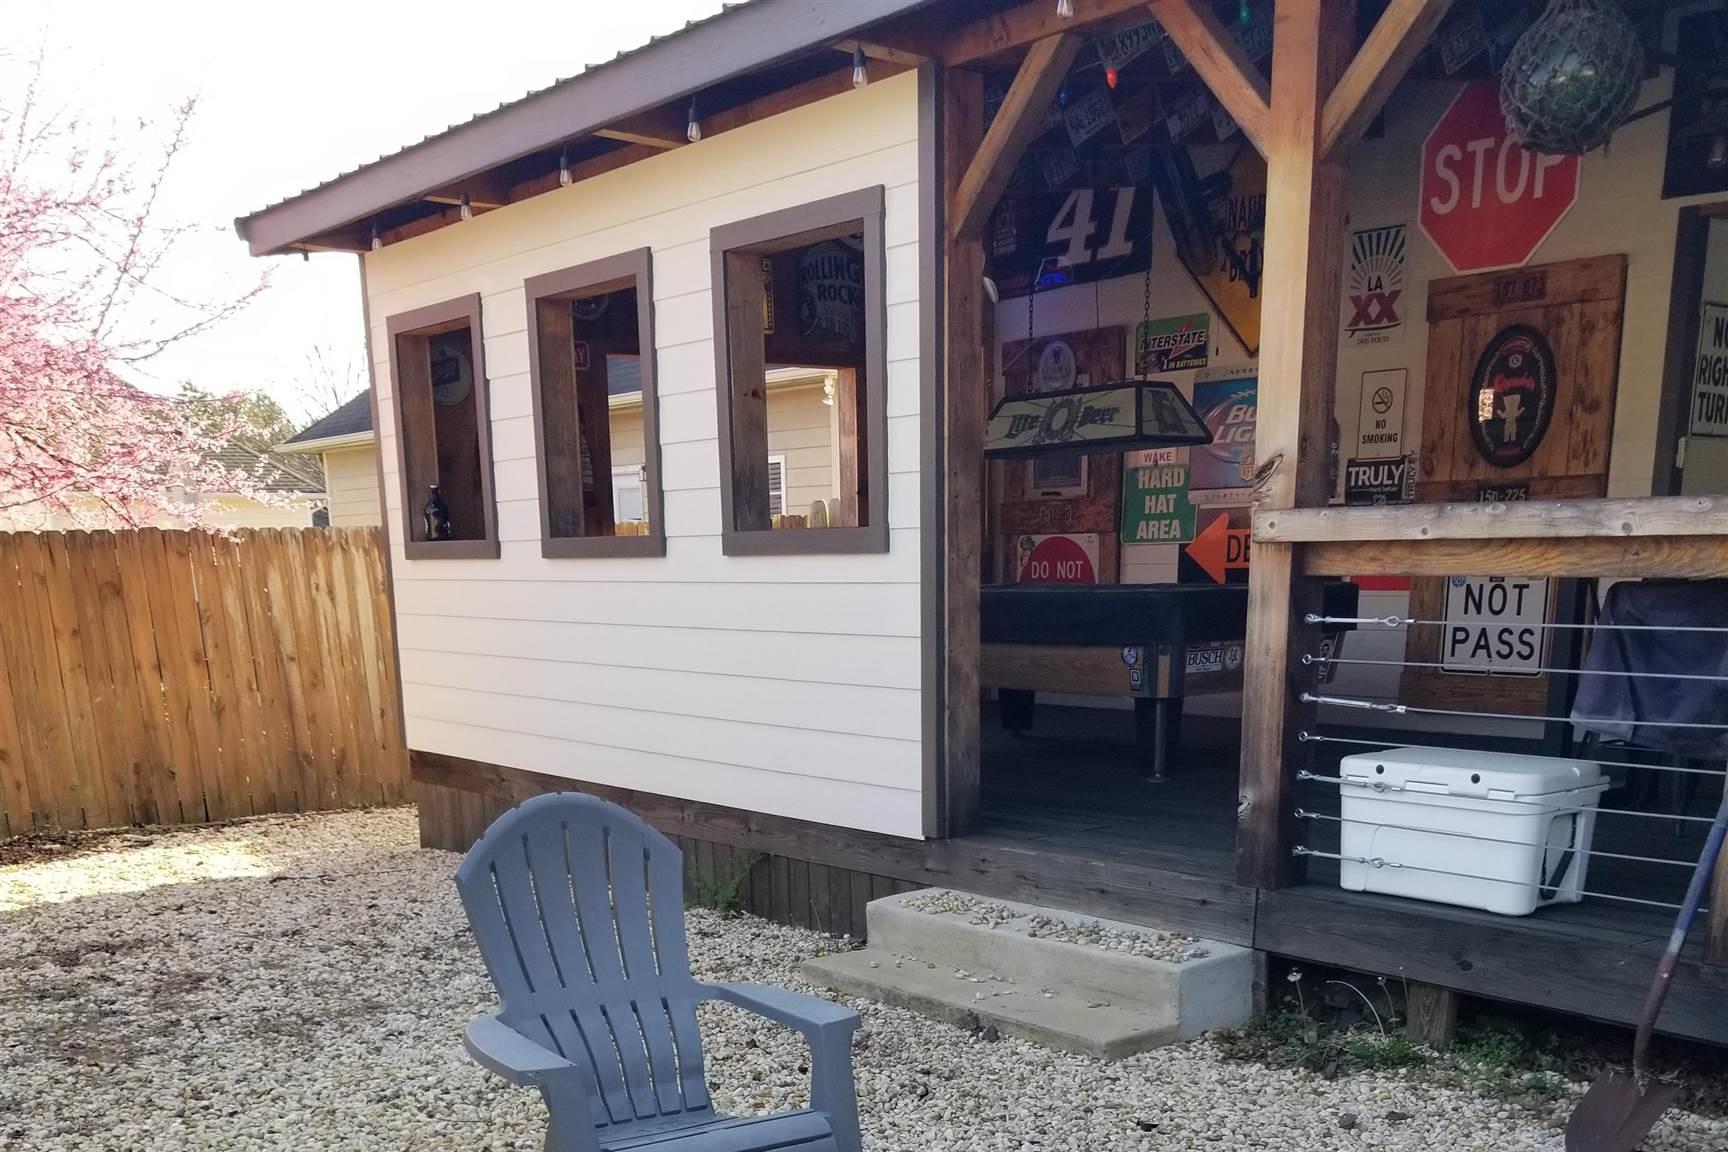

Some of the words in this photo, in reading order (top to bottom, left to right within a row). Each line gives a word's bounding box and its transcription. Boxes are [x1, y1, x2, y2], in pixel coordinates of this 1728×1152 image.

[1430, 132, 1566, 215] STOP
[1045, 186, 1137, 268] 41
[800, 255, 859, 284] ROLLING
[817, 282, 857, 305] ROCK
[1368, 275, 1384, 292] LA
[1347, 290, 1402, 328] XX
[1226, 404, 1257, 424] BU
[1375, 419, 1387, 429] NO
[1212, 425, 1257, 443] LIG
[1361, 432, 1398, 444] SMOKING
[1143, 451, 1173, 463] WAKE
[1138, 467, 1185, 489] HARD
[1348, 464, 1405, 487] TRULY
[1144, 493, 1177, 514] HAT
[1135, 519, 1182, 540] AREA
[1031, 560, 1049, 579] DO
[1056, 560, 1084, 579] NOT
[1462, 583, 1530, 616] NOT
[1449, 626, 1536, 662] PASS
[1186, 650, 1225, 666] BUSCH
